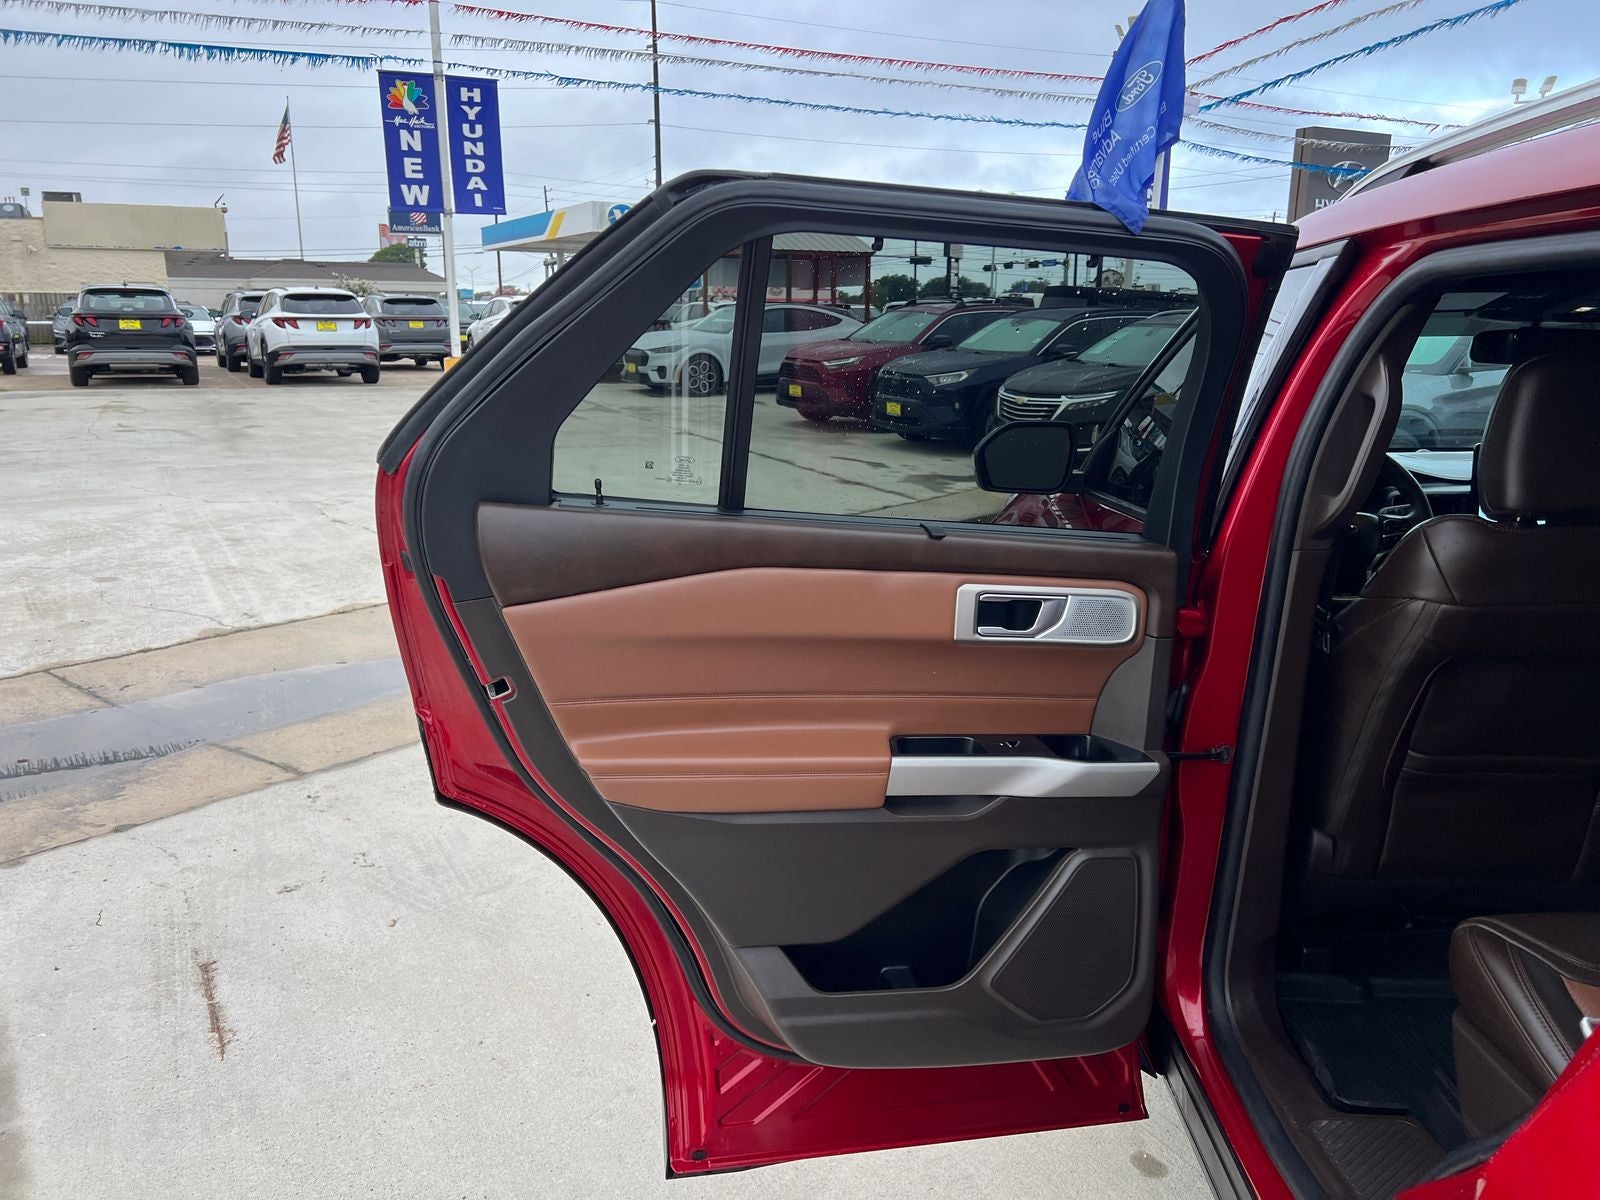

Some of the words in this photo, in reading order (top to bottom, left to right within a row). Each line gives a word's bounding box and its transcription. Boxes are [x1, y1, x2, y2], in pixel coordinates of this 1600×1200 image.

[398, 128, 430, 206] NEW
[459, 86, 488, 207] HYUNDAI
[408, 238, 427, 247] atm
